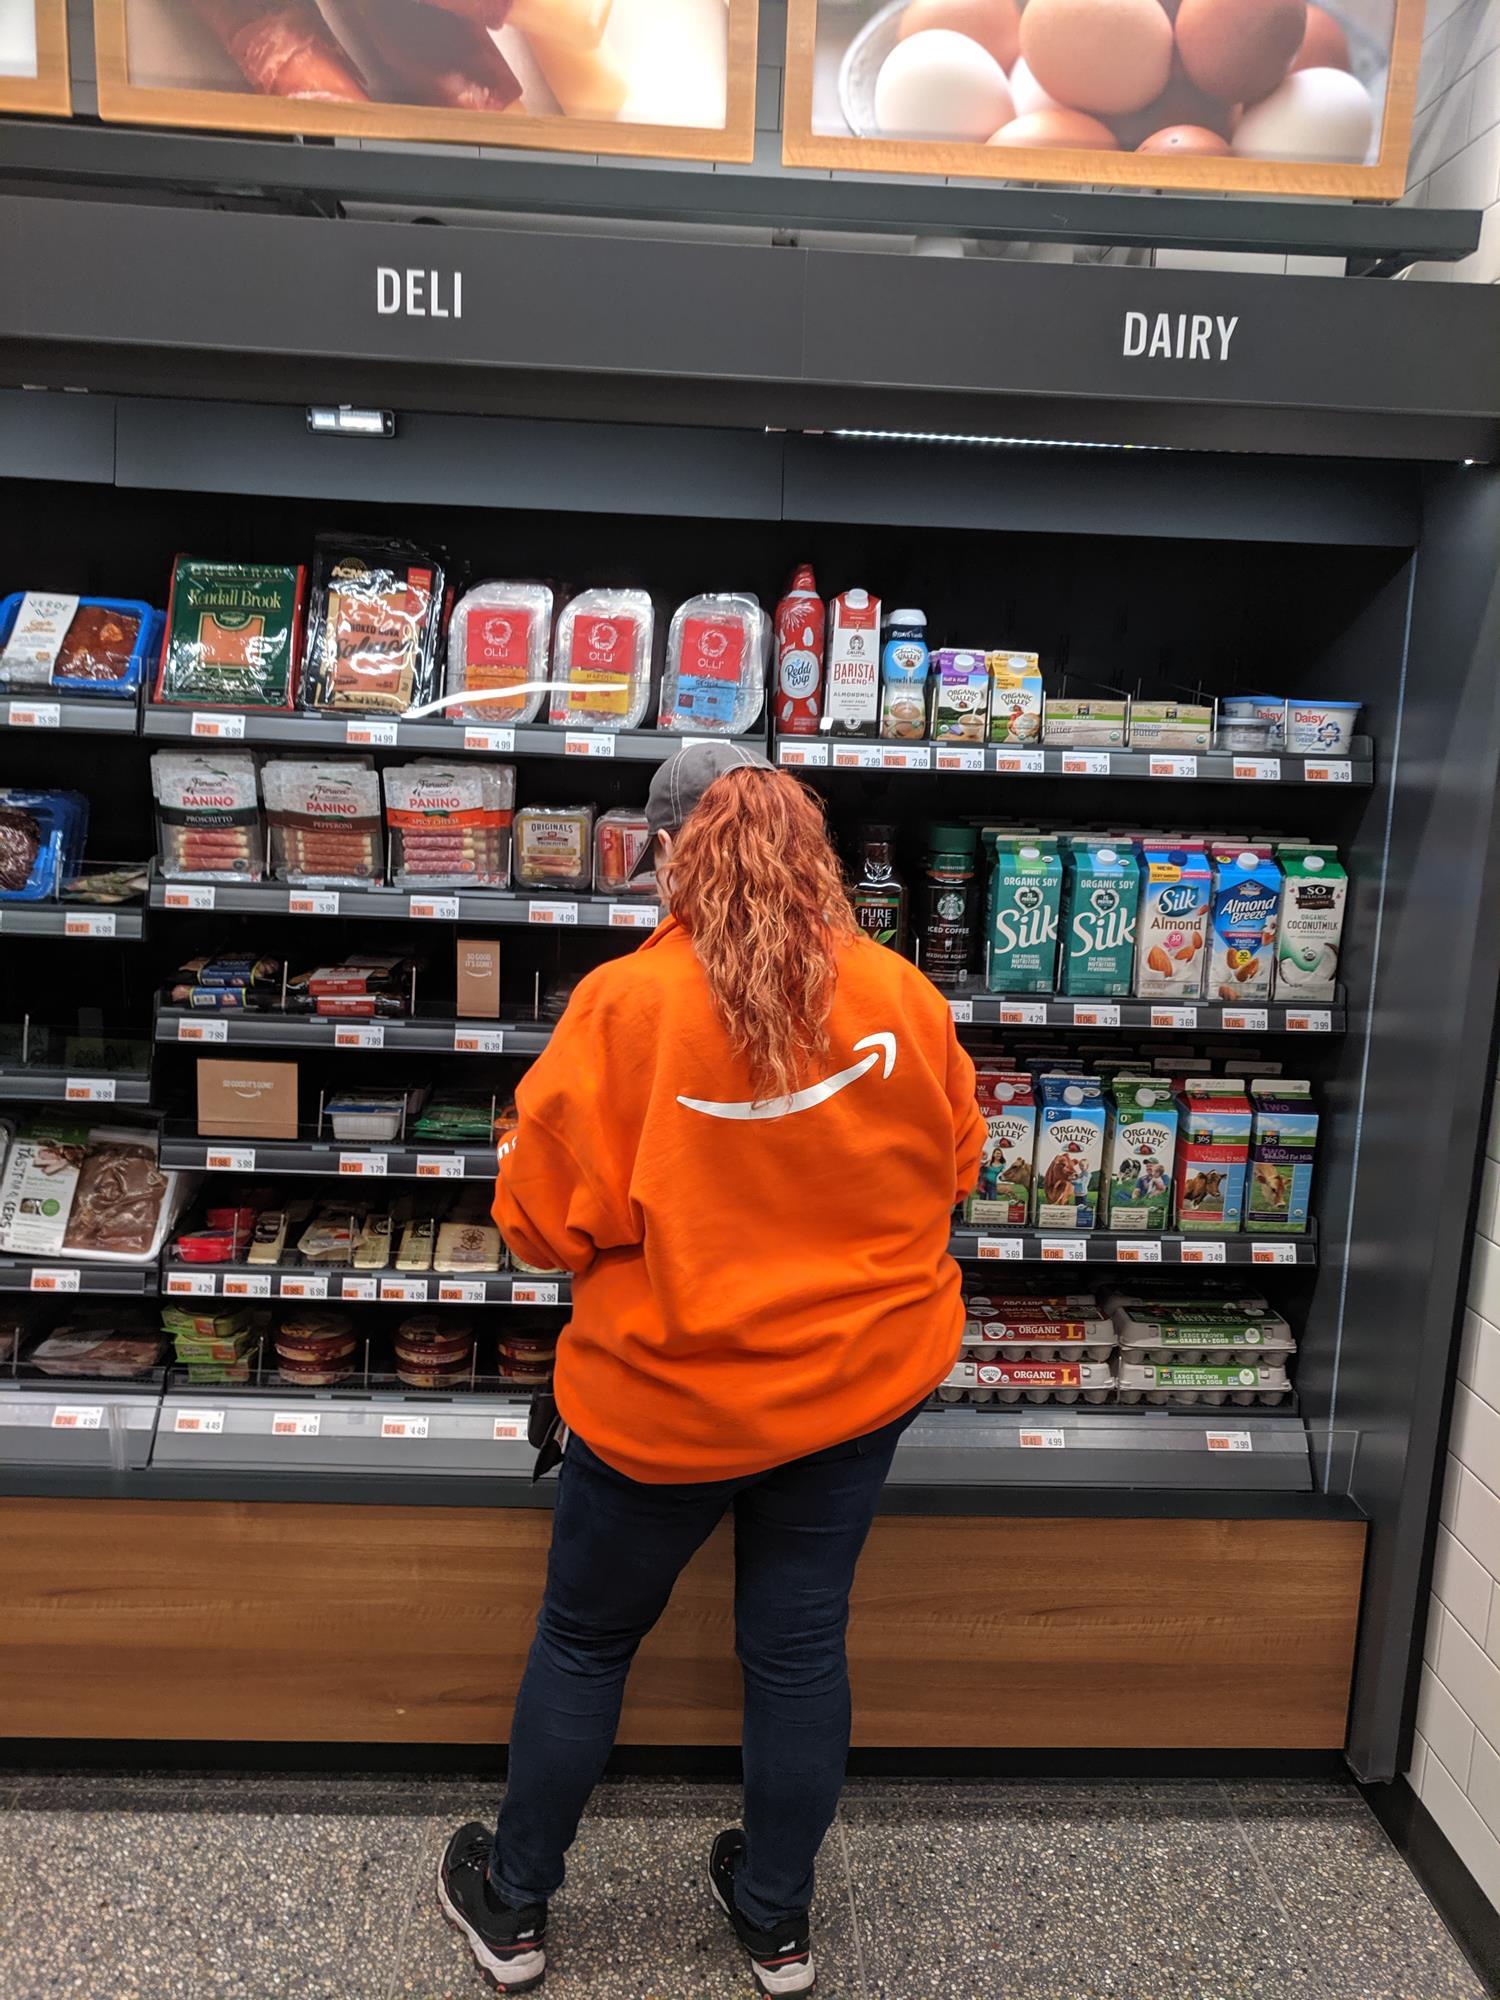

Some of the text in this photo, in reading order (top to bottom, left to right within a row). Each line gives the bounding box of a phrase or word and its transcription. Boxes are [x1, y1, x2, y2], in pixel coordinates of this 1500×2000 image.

[377, 266, 462, 318] DELI
[1123, 311, 1240, 361] DAIRY
[189, 589, 281, 608] Kendall Brook
[484, 647, 508, 657] OLLI
[589, 652, 613, 662] OLLI
[698, 658, 721, 669] OLLI
[785, 660, 812, 679] Reddi
[834, 662, 875, 682] BARISTA
[947, 689, 979, 698] ORGANIC
[950, 695, 975, 703] VALLEY
[1001, 693, 1033, 701] ORGANIC
[1256, 708, 1285, 722] Daisy
[1295, 710, 1328, 726] Daisy
[1045, 725, 1072, 734] Butter
[1133, 728, 1160, 737] Butter
[182, 796, 234, 806] PANINO
[409, 798, 460, 808] PANINO
[306, 802, 358, 814] PANINO
[531, 823, 573, 833] ORIGINALS
[1004, 877, 1058, 887] ORGANIC SOY
[1081, 879, 1135, 889] ORGANIC SOY
[1307, 886, 1326, 895] SO
[1159, 889, 1197, 914] Silk
[1221, 896, 1276, 915] Almond
[861, 908, 892, 918] PURE
[1231, 909, 1266, 924] Breeze
[995, 905, 1059, 954] Silk
[1151, 917, 1202, 931] Almond
[1287, 920, 1338, 931] COCONUTMILK
[928, 926, 969, 934] ICED COFFEE
[1071, 907, 1136, 958] Silk
[1050, 1125, 1098, 1138] ORGANIC
[1123, 1127, 1169, 1141] ORGANIC
[1196, 1135, 1210, 1144] 365
[1264, 1136, 1277, 1144] 365
[1019, 1324, 1082, 1339] ORGANIC L
[1013, 1368, 1077, 1384] ORGANIC L
